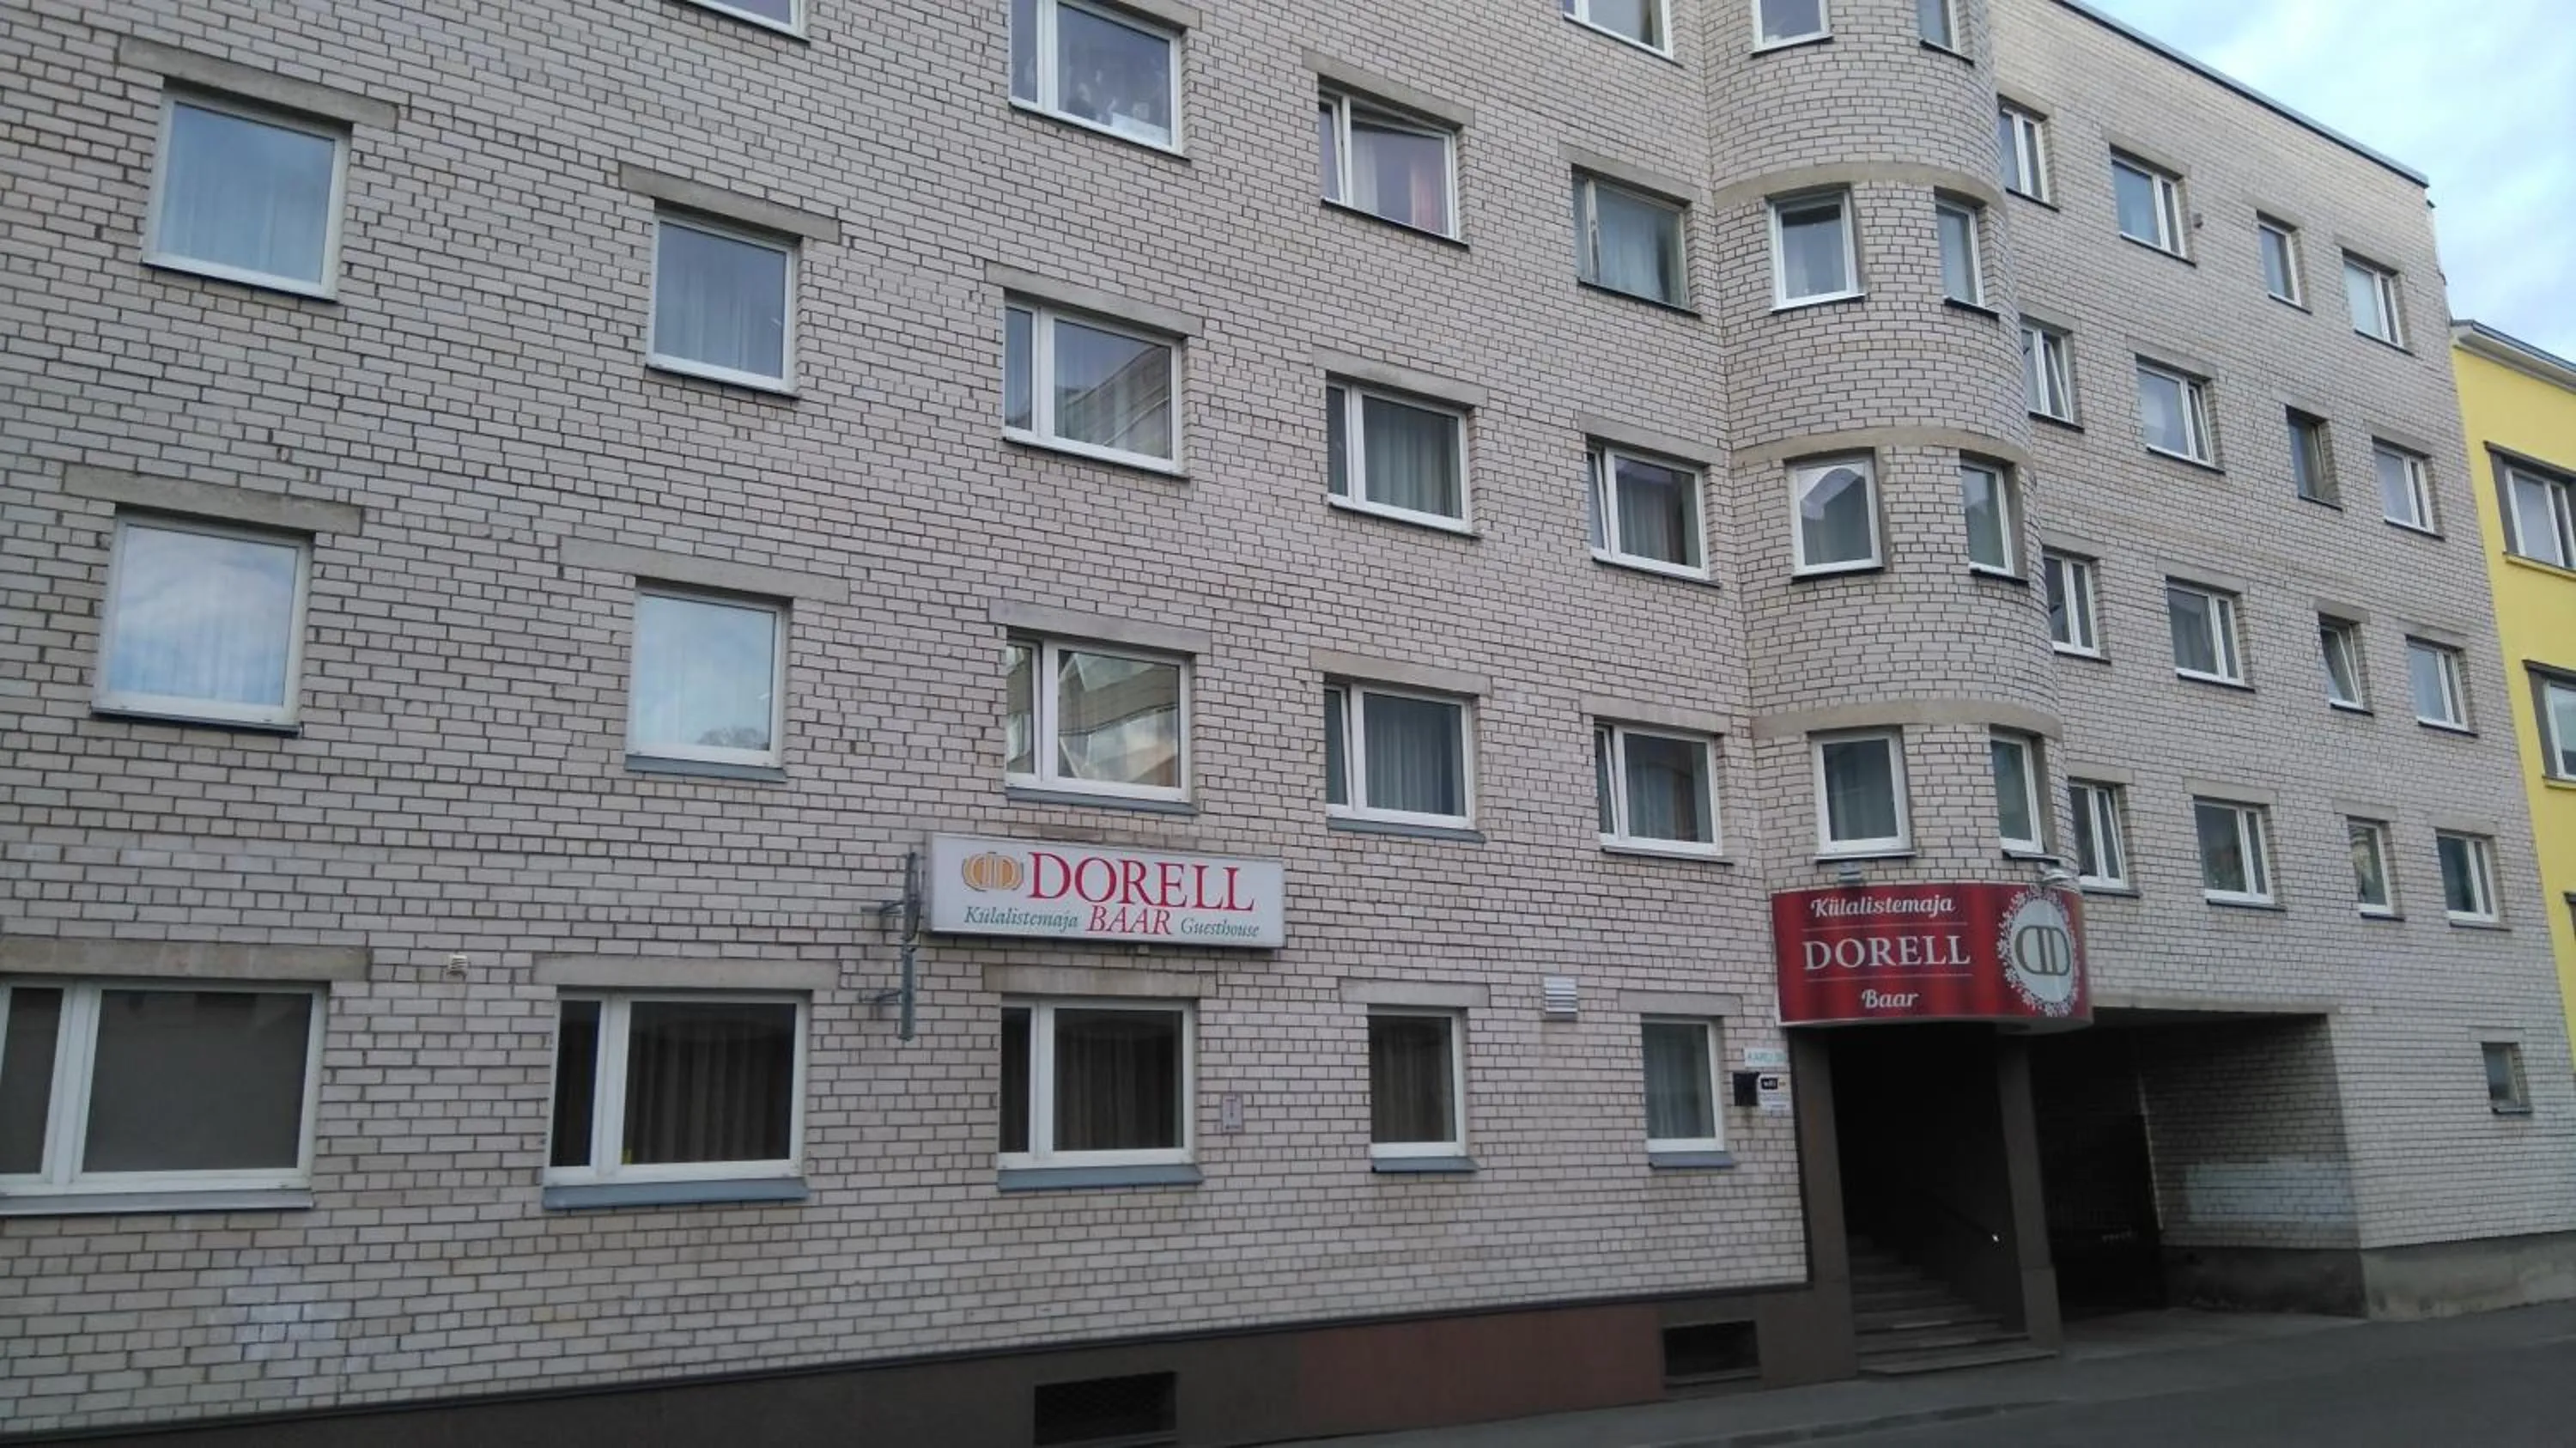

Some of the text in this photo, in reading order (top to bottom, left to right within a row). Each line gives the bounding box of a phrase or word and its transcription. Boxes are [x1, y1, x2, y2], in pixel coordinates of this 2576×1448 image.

[1028, 851, 1255, 911] DORELL
[963, 905, 1260, 937] Külalistemaja BAAR Guesthouse
[1811, 895, 1955, 918] Külalistemaja
[1802, 935, 1971, 970] DORELL
[1862, 989, 1920, 1009] Baar
